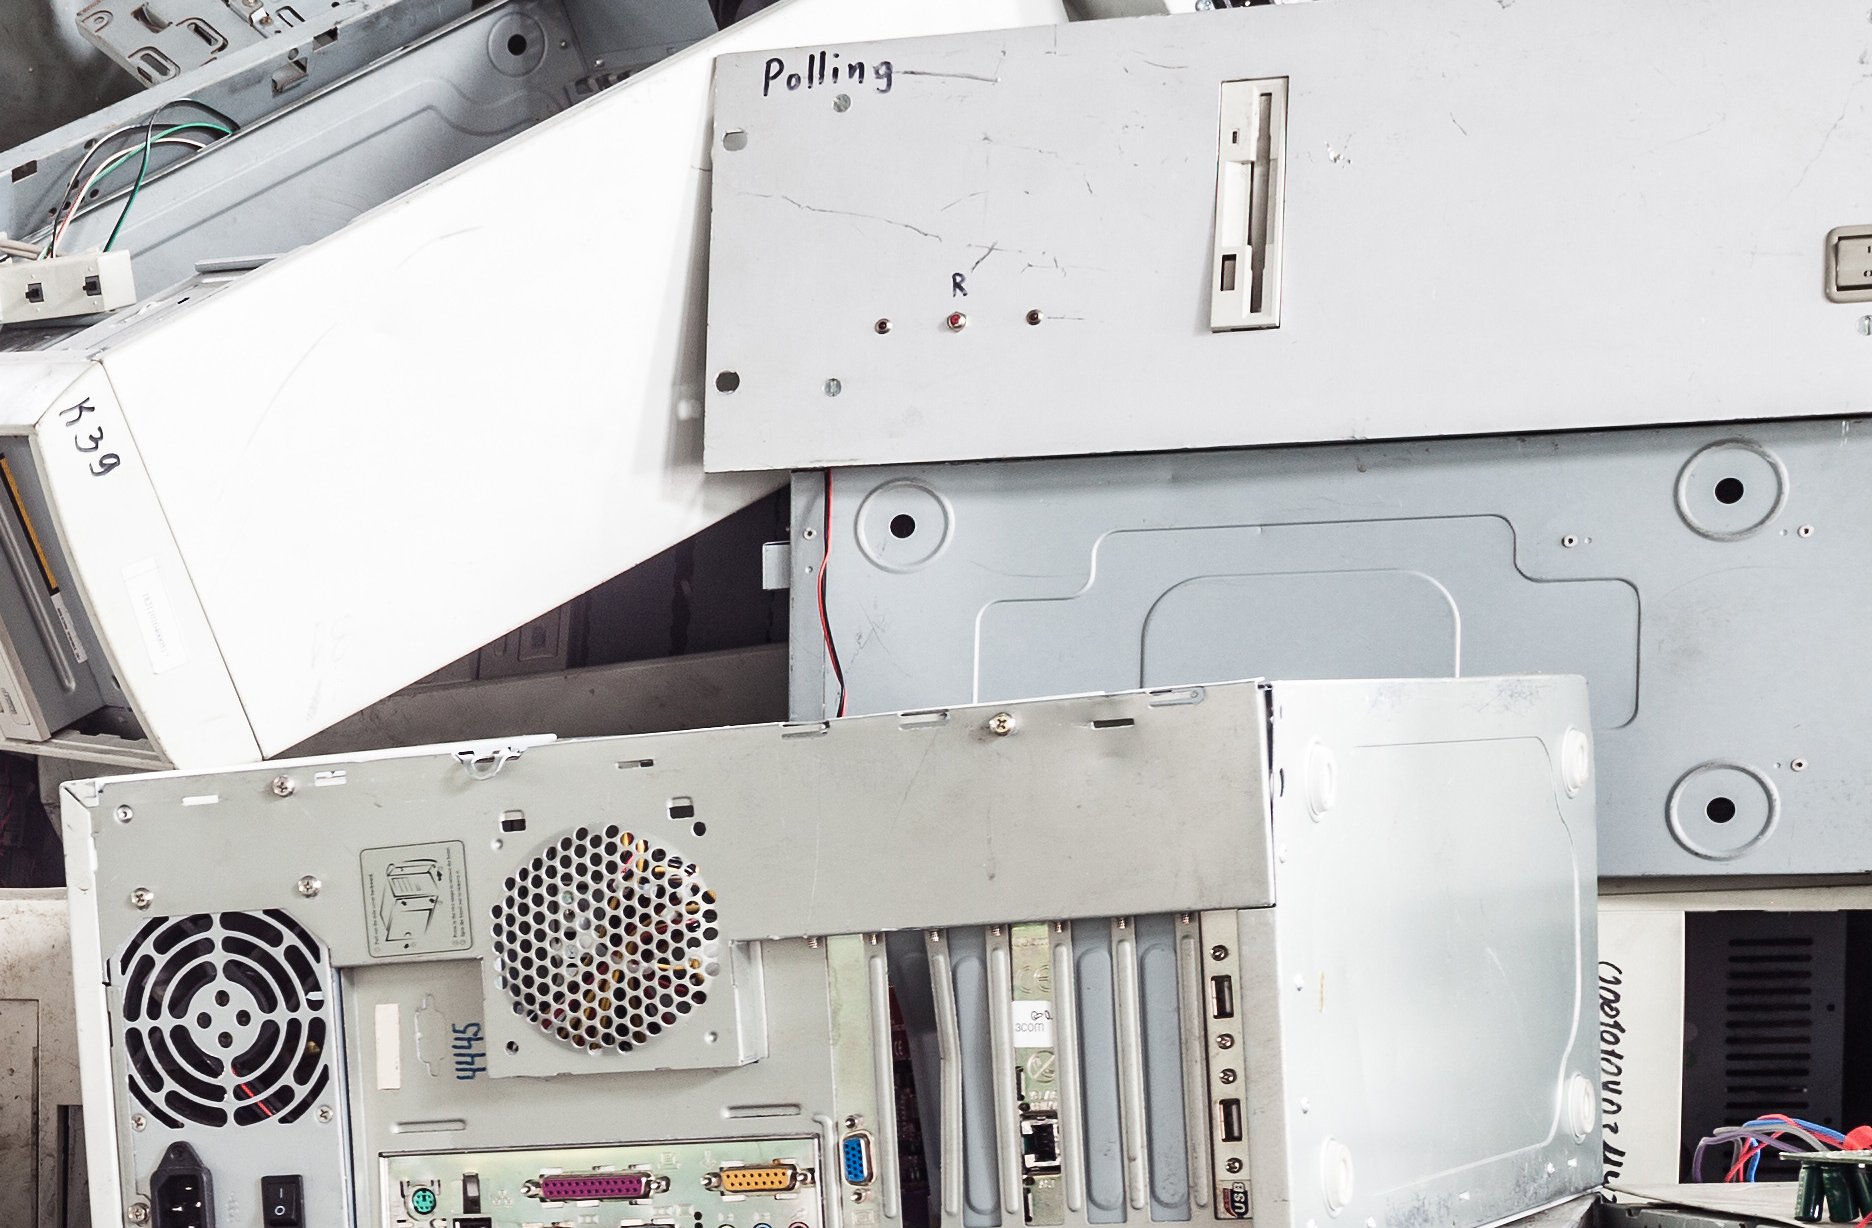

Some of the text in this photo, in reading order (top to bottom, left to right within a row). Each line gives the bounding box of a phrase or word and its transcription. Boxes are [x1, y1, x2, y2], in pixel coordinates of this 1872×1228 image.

[764, 51, 893, 97] Polling
[952, 273, 967, 297] R
[452, 1022, 482, 1081] 4445
[1232, 1181, 1248, 1213] USB
